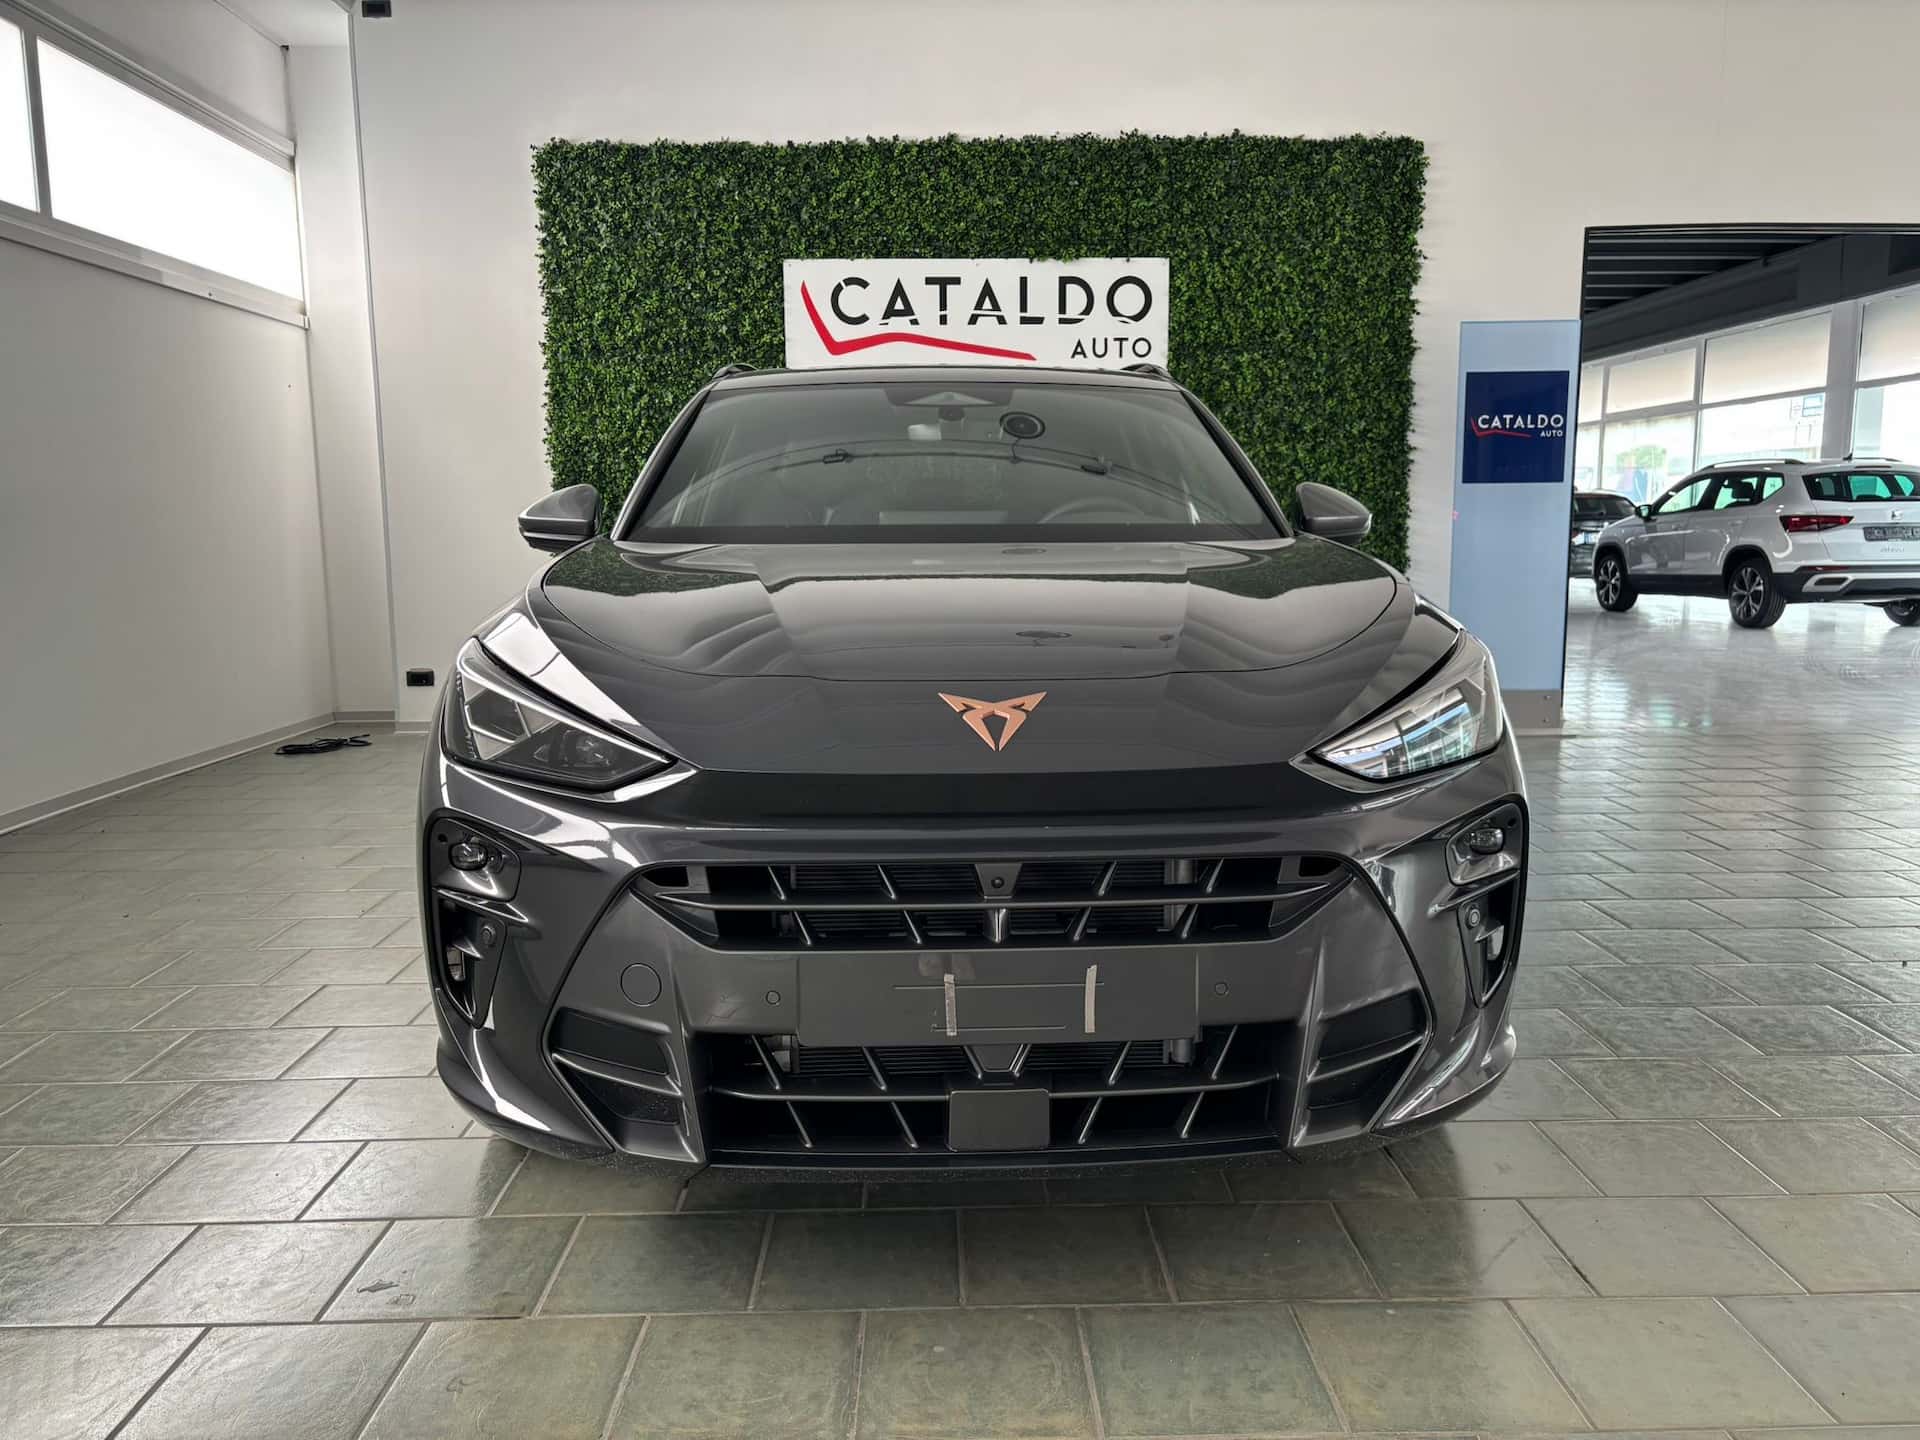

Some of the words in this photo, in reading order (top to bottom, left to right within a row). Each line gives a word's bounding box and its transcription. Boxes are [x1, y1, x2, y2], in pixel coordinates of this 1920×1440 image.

[830, 275, 1153, 326] CATALDO
[1070, 336, 1153, 359] AUTO
[1477, 414, 1564, 429] CATALDO
[1540, 430, 1563, 438] AUTO
